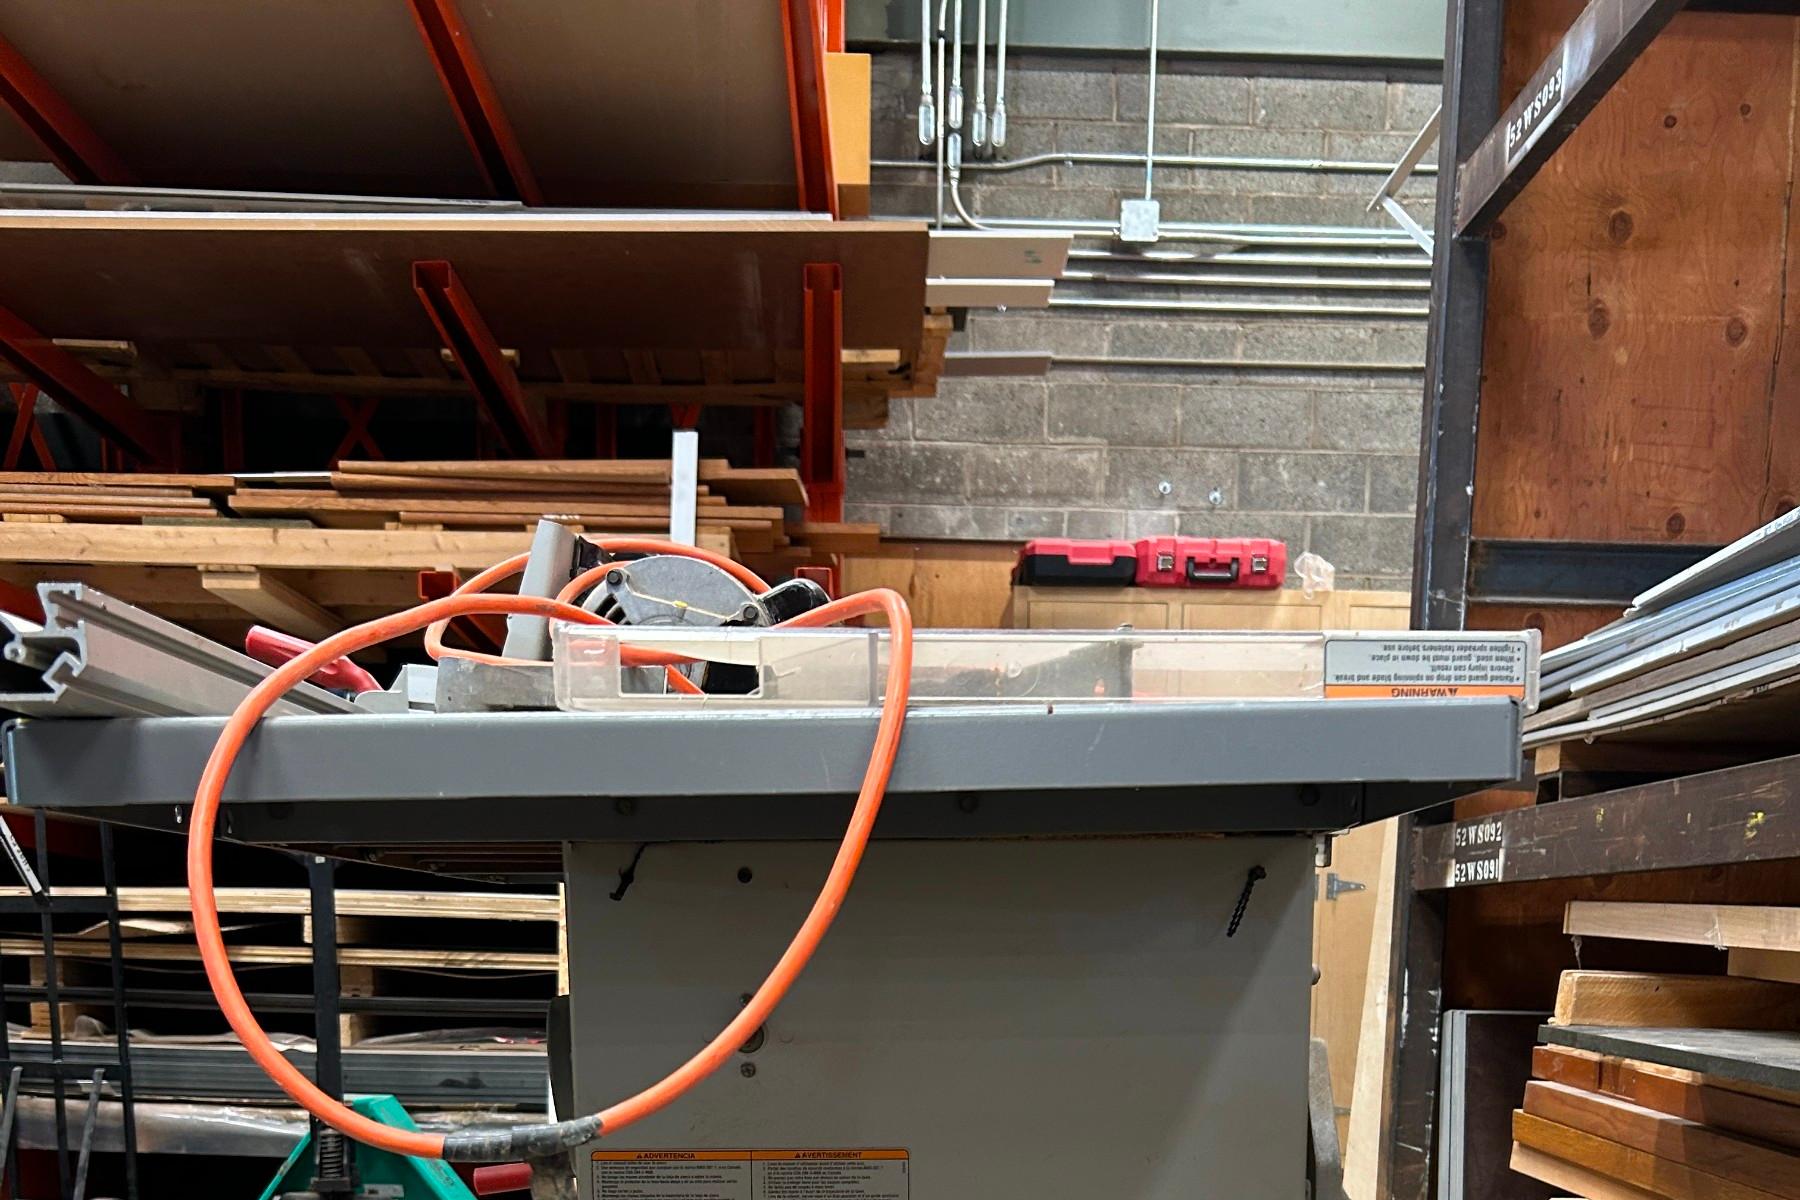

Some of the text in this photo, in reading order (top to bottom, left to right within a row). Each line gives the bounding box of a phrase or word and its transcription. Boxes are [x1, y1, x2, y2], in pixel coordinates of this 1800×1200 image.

[1510, 67, 1562, 148] 52WS093
[1398, 644, 1420, 652] before
[1457, 644, 1487, 652] spreader
[1489, 644, 1515, 653] Tighten
[1452, 654, 1472, 662] guard
[1490, 665, 1514, 673] Severe
[1372, 674, 1392, 682] blade
[1393, 673, 1423, 682] spinning
[1436, 674, 1452, 682] drop
[1468, 673, 1488, 682] guard
[1391, 688, 1448, 697] WARNING
[643, 1152, 696, 1160] ADVERTENCIA
[802, 1151, 862, 1159] AVERTISSEMENT
